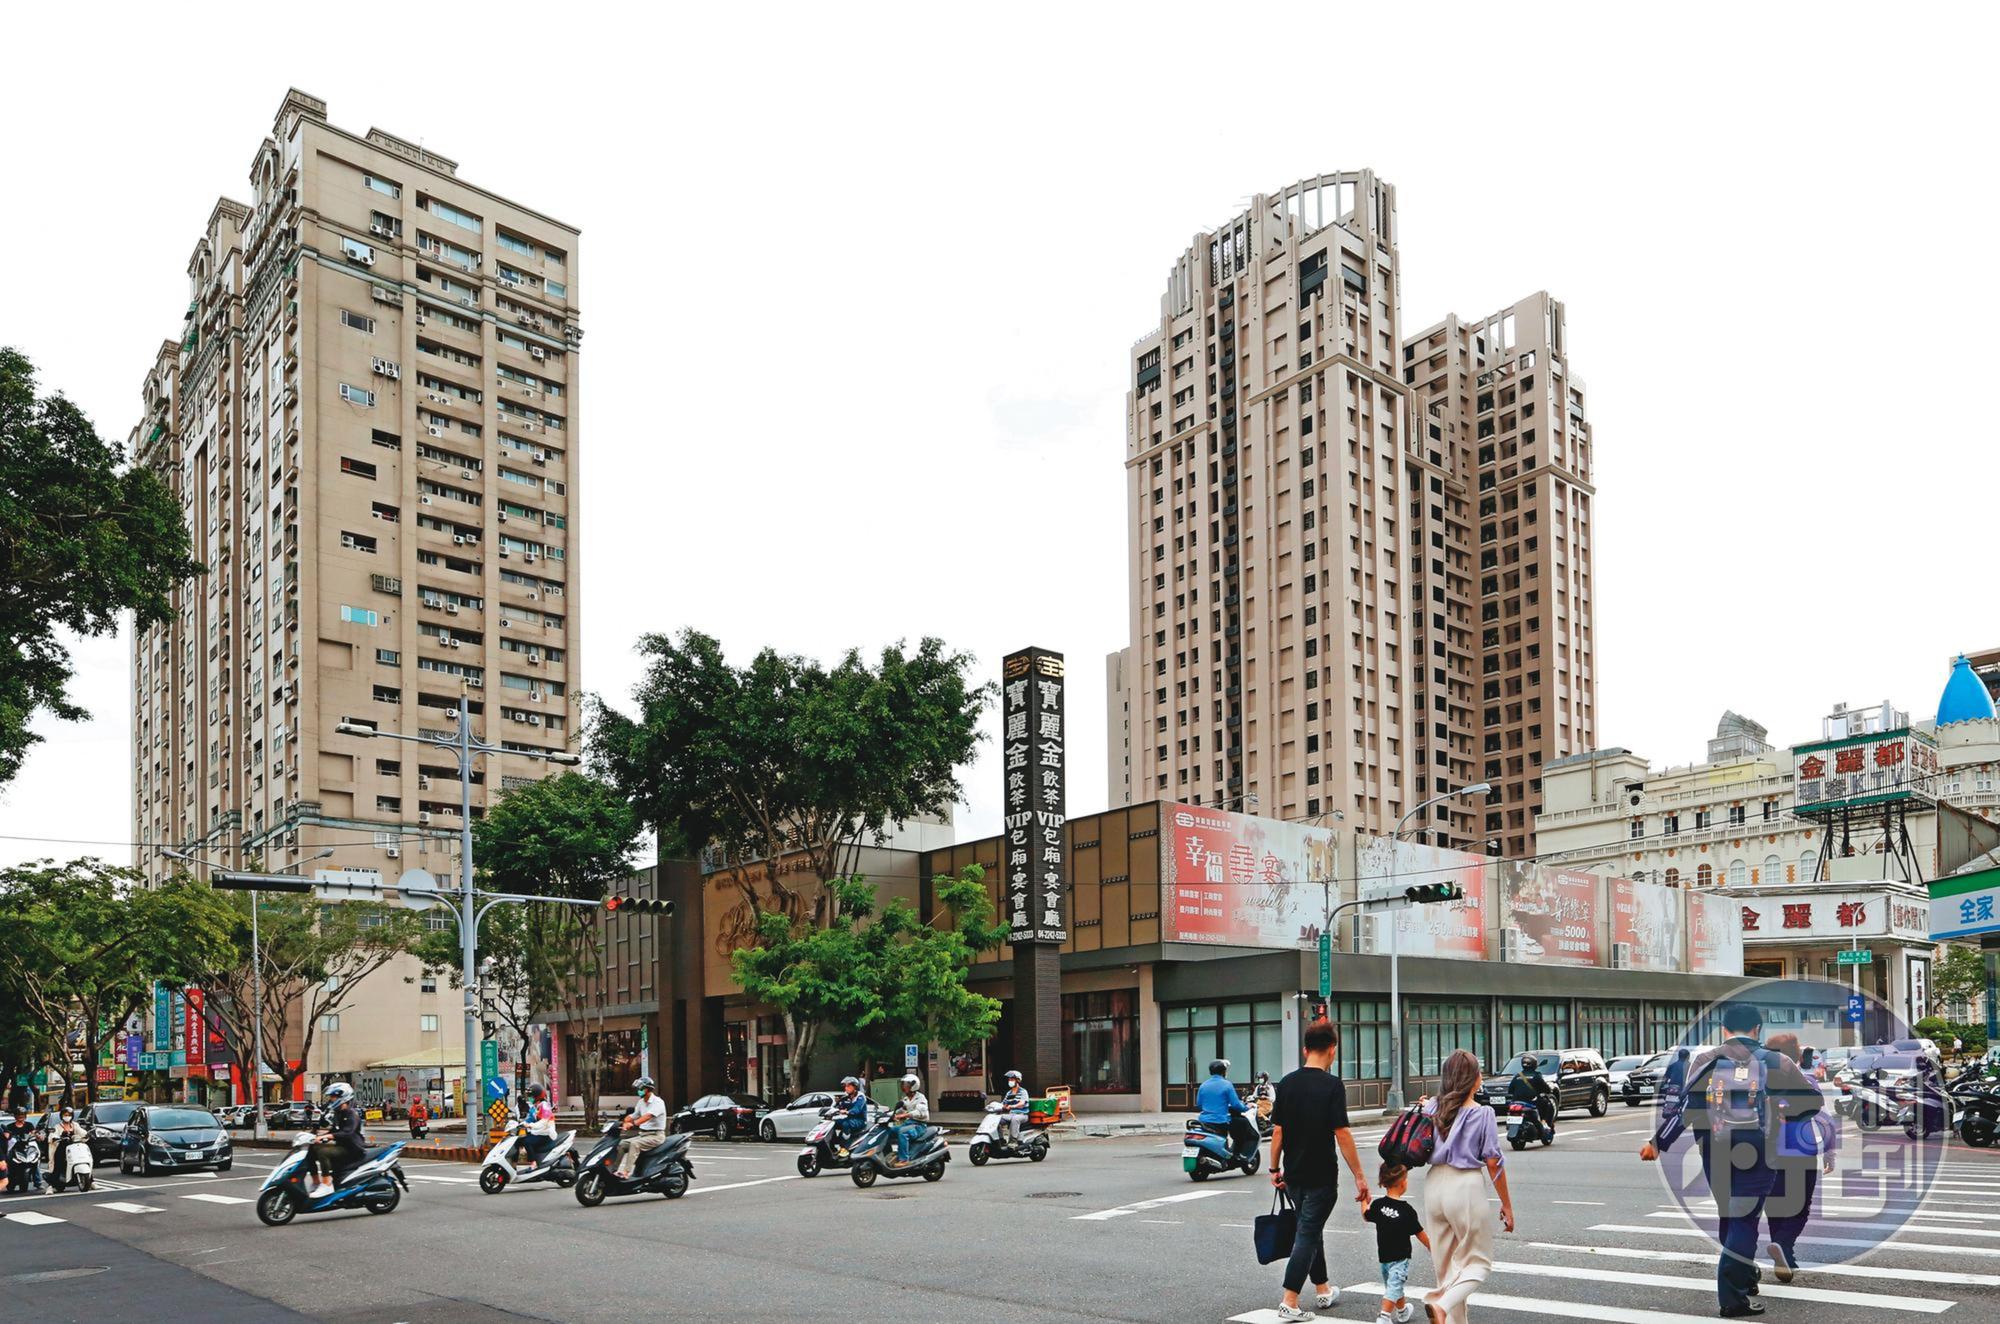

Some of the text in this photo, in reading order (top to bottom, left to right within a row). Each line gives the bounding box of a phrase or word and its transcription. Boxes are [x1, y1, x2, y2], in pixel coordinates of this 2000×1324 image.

[1005, 678, 1030, 770] 寶麗金
[1037, 678, 1064, 770] 寶麗金
[1799, 741, 1905, 780] 金麗都
[1959, 895, 1994, 924] 全家
